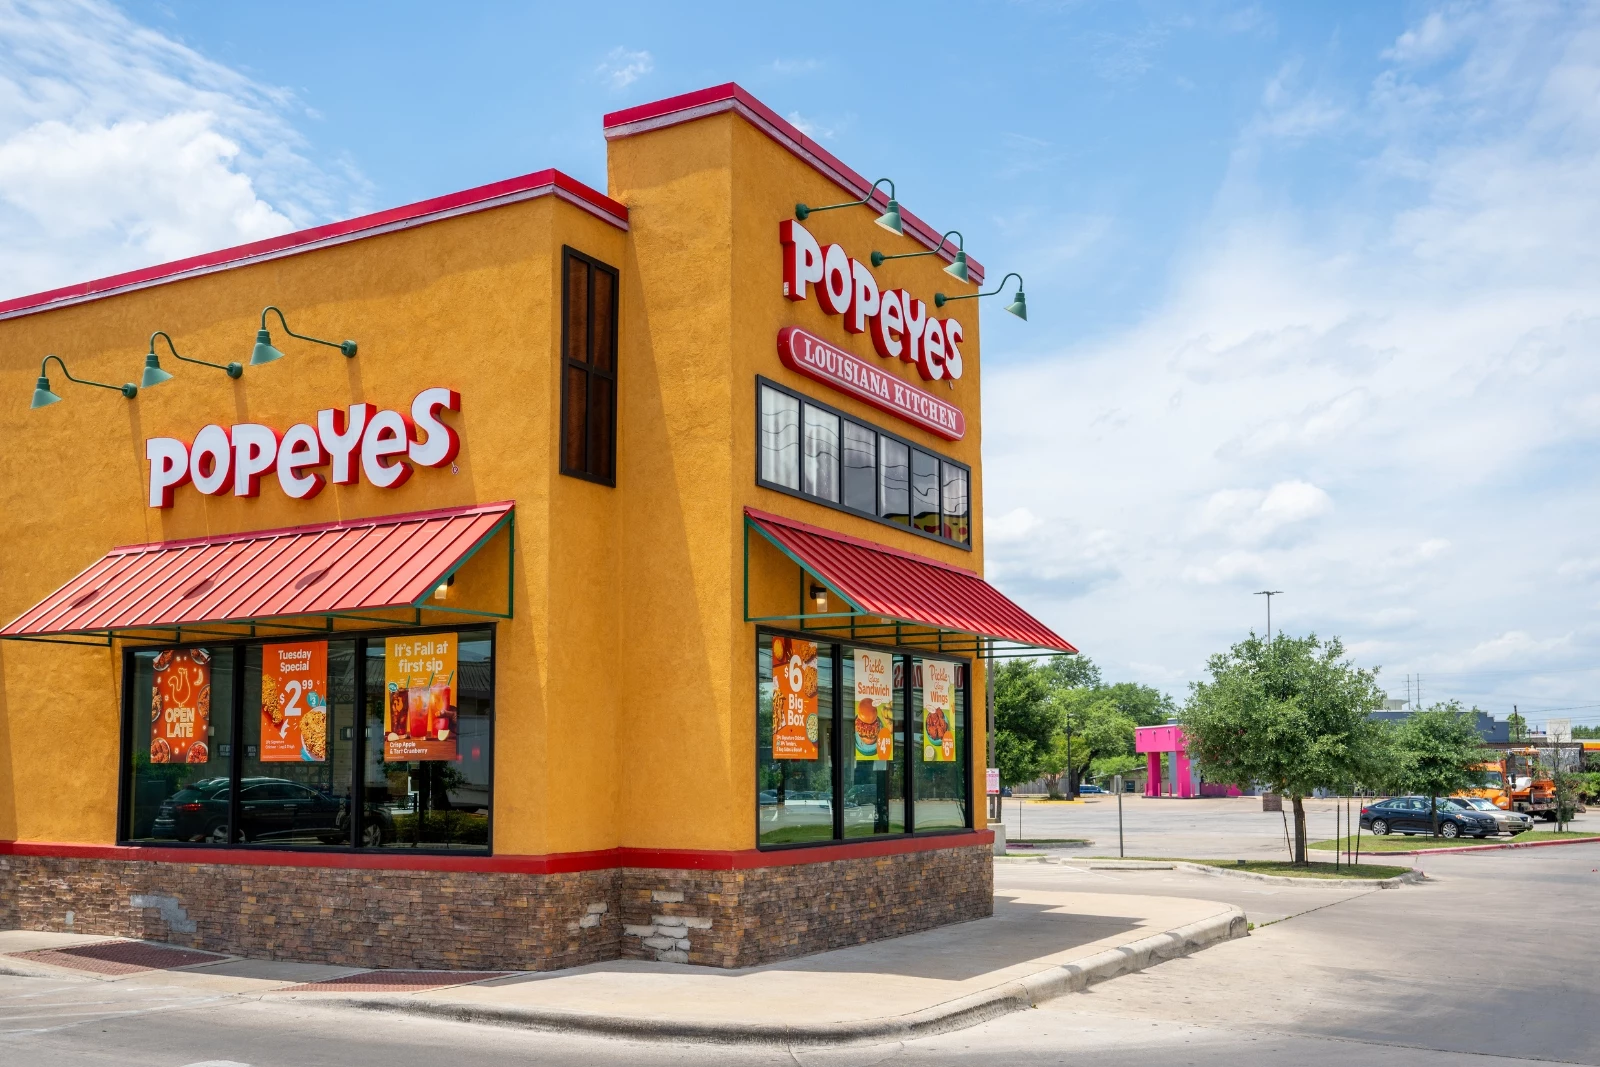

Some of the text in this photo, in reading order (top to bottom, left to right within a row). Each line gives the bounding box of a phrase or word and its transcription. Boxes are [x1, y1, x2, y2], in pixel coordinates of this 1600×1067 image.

[804, 338, 957, 431] LOUISIANA KITCHEN
[394, 640, 448, 657] It's Fall at
[278, 649, 312, 674] Tuesday Special
[398, 657, 443, 674] first sip
[862, 654, 885, 674] Pickle
[928, 664, 948, 682] Pickle
[857, 681, 890, 697] Sandwich
[788, 693, 804, 714] Big
[930, 690, 948, 706] Wings
[164, 707, 195, 723] OPEN
[787, 709, 805, 727] Box
[166, 722, 194, 738] LATE
[389, 741, 402, 749] Crisp
[403, 747, 428, 755] Cranberry
